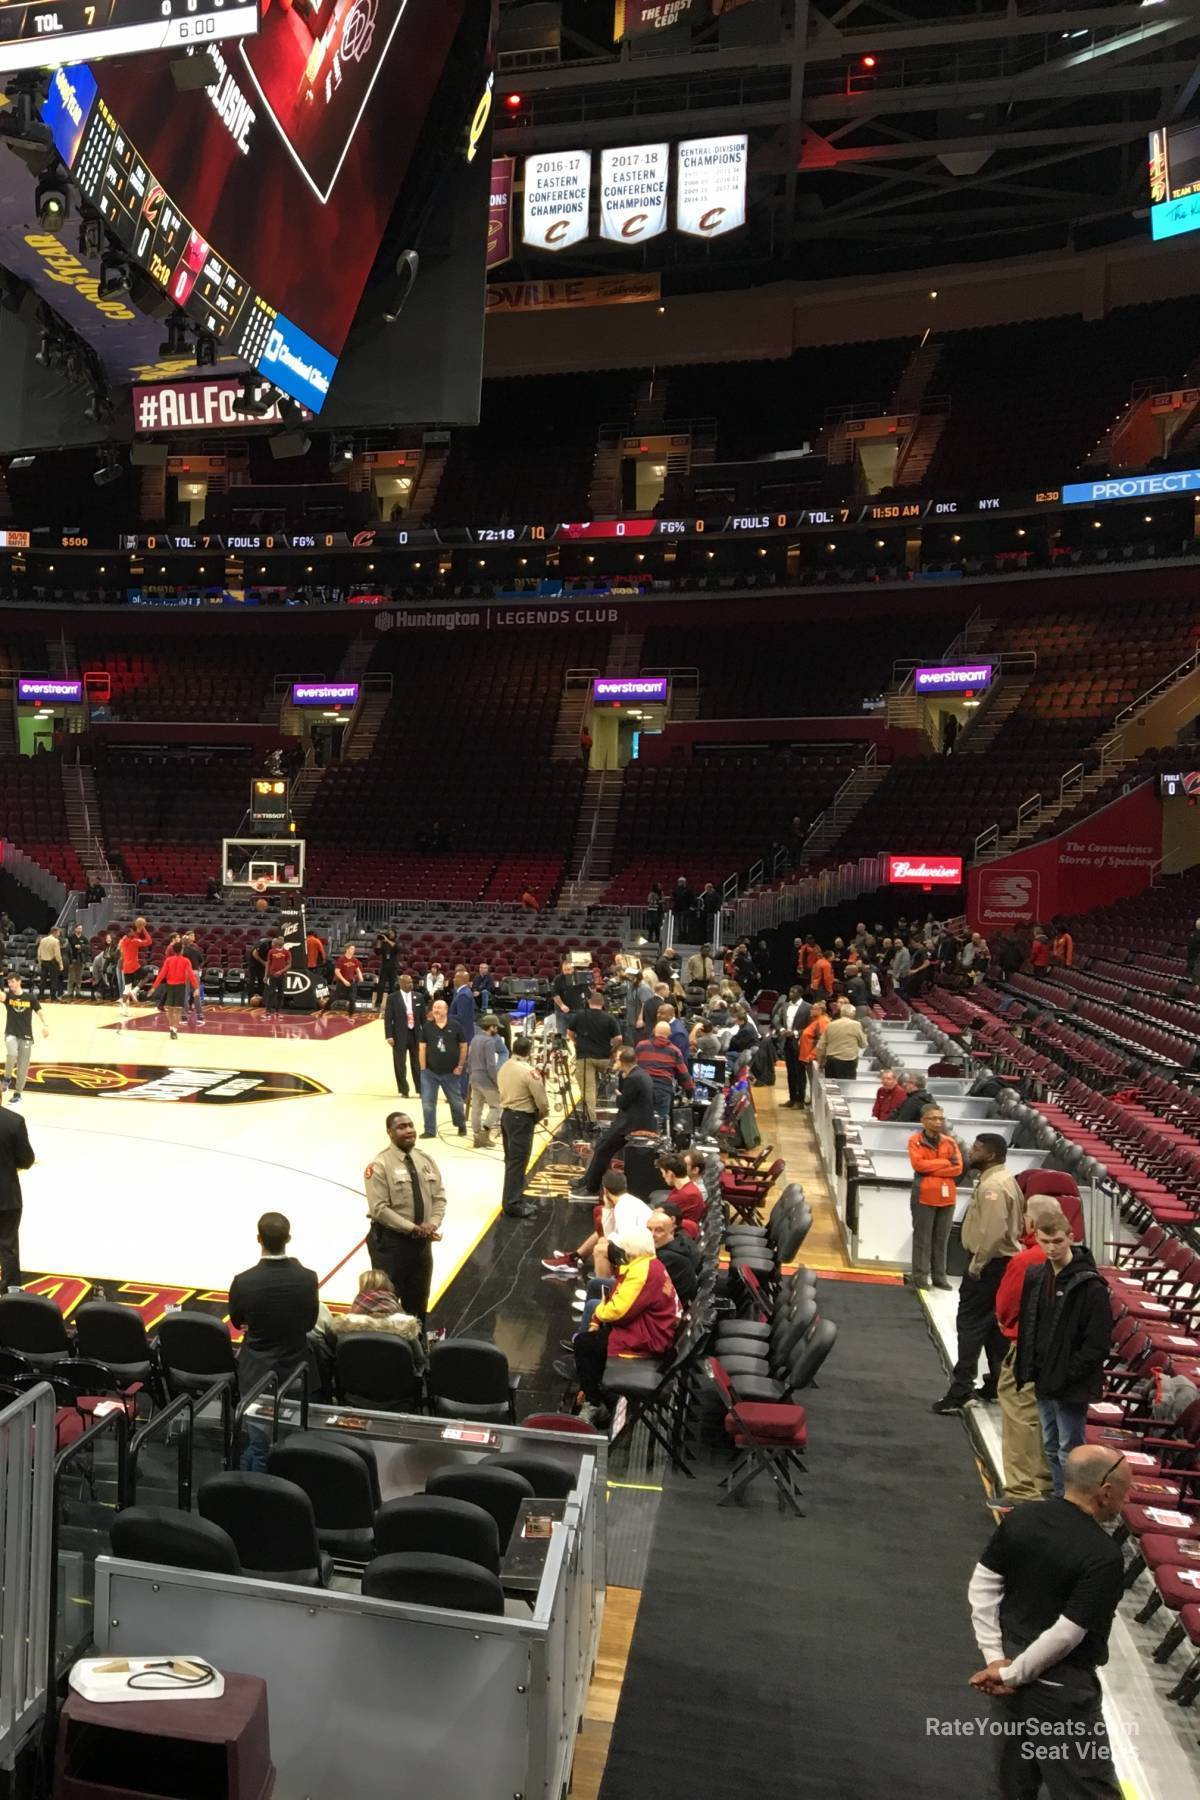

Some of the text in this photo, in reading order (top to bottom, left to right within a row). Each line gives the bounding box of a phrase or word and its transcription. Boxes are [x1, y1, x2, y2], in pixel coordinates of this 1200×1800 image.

[34, 13, 63, 33] TOL
[84, 7, 96, 25] 7
[641, 7, 660, 21] THE
[680, 143, 745, 157] CENTRAL DIVISION
[536, 159, 581, 174] 2016-17
[611, 152, 659, 167] 2017-18
[683, 152, 742, 168] CHAMPIONS
[536, 175, 578, 189] EASTERN
[612, 169, 656, 183] EASTERN
[528, 187, 586, 204] CONFERENCE
[603, 181, 665, 198] CONFERENCE
[530, 203, 584, 216] CHAMPIONS
[605, 196, 662, 210] CHAMPIONS
[1092, 473, 1192, 500] PROTECT
[1035, 491, 1059, 504] 12:30
[872, 504, 920, 519] 11:50 AM
[935, 498, 1000, 514] OKC NYK
[733, 514, 787, 530] FOULS 0
[808, 509, 849, 524] TOL: 7
[616, 523, 625, 536] 0
[660, 519, 705, 533] FG% 0
[61, 536, 89, 547] $500
[175, 536, 211, 548] TOL: 7
[228, 536, 274, 548] FOULS 0
[292, 535, 334, 548] FG% 0
[399, 531, 408, 545] 0
[477, 529, 515, 541] 72:18
[396, 608, 619, 629] Huntington LEGENDS CLUB
[919, 669, 987, 685] everstream
[22, 683, 79, 695] everstream
[296, 686, 356, 699] everstream
[597, 681, 663, 696] everstream
[1066, 842, 1153, 854] The Convenience
[1058, 854, 1092, 865] Stores
[1094, 855, 1107, 868] of
[891, 862, 959, 878] Budweiser
[983, 909, 1033, 921] Speedway
